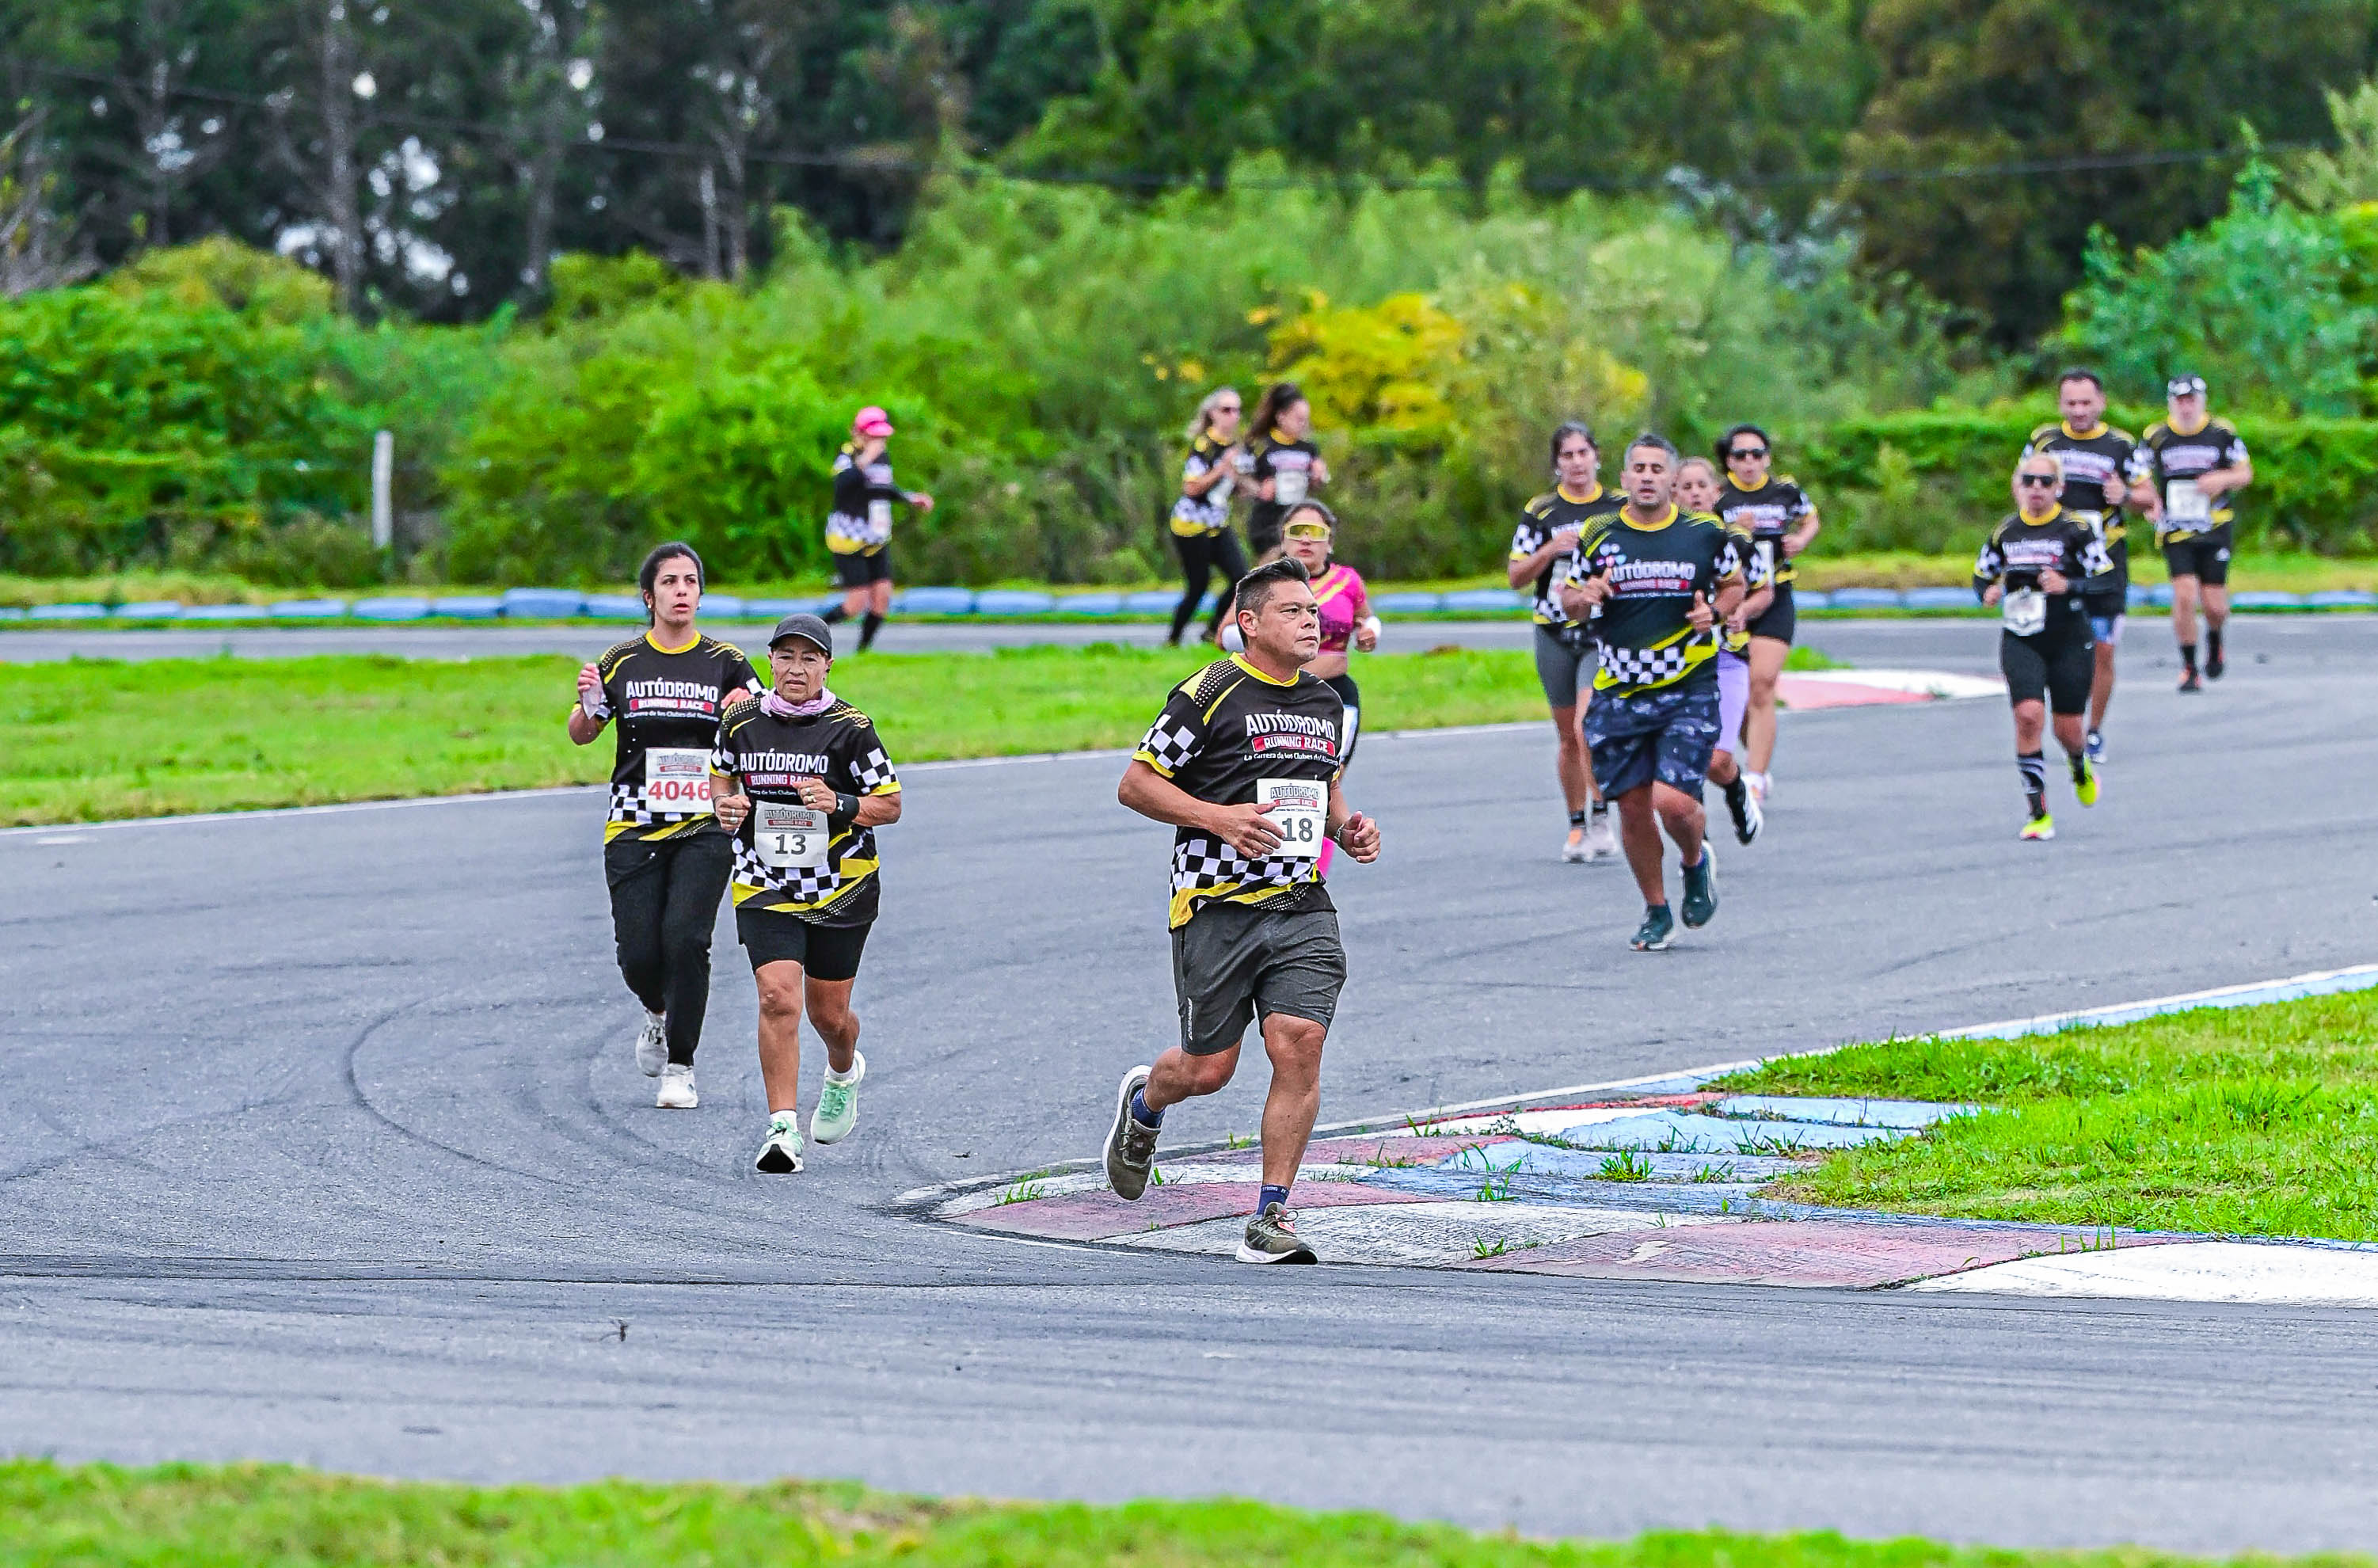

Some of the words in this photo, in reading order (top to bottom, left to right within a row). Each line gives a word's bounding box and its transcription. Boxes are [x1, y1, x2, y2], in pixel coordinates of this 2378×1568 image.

[626, 676, 719, 703] AUTÓDROMO
[638, 698, 678, 710] RUNNING
[679, 698, 705, 711] RACE
[1244, 708, 1336, 741] AUTÓDROMO
[1264, 736, 1302, 750] RUNNING
[1303, 736, 1329, 753] RACE
[740, 748, 829, 774] AUTÓDROMO
[648, 780, 711, 801] 4046
[750, 774, 788, 786] RUNNING
[1270, 782, 1320, 800] AUTÓDROMO
[764, 807, 816, 821] AUTÓDROMO
[1281, 817, 1313, 843] 18
[774, 834, 806, 855] 13
